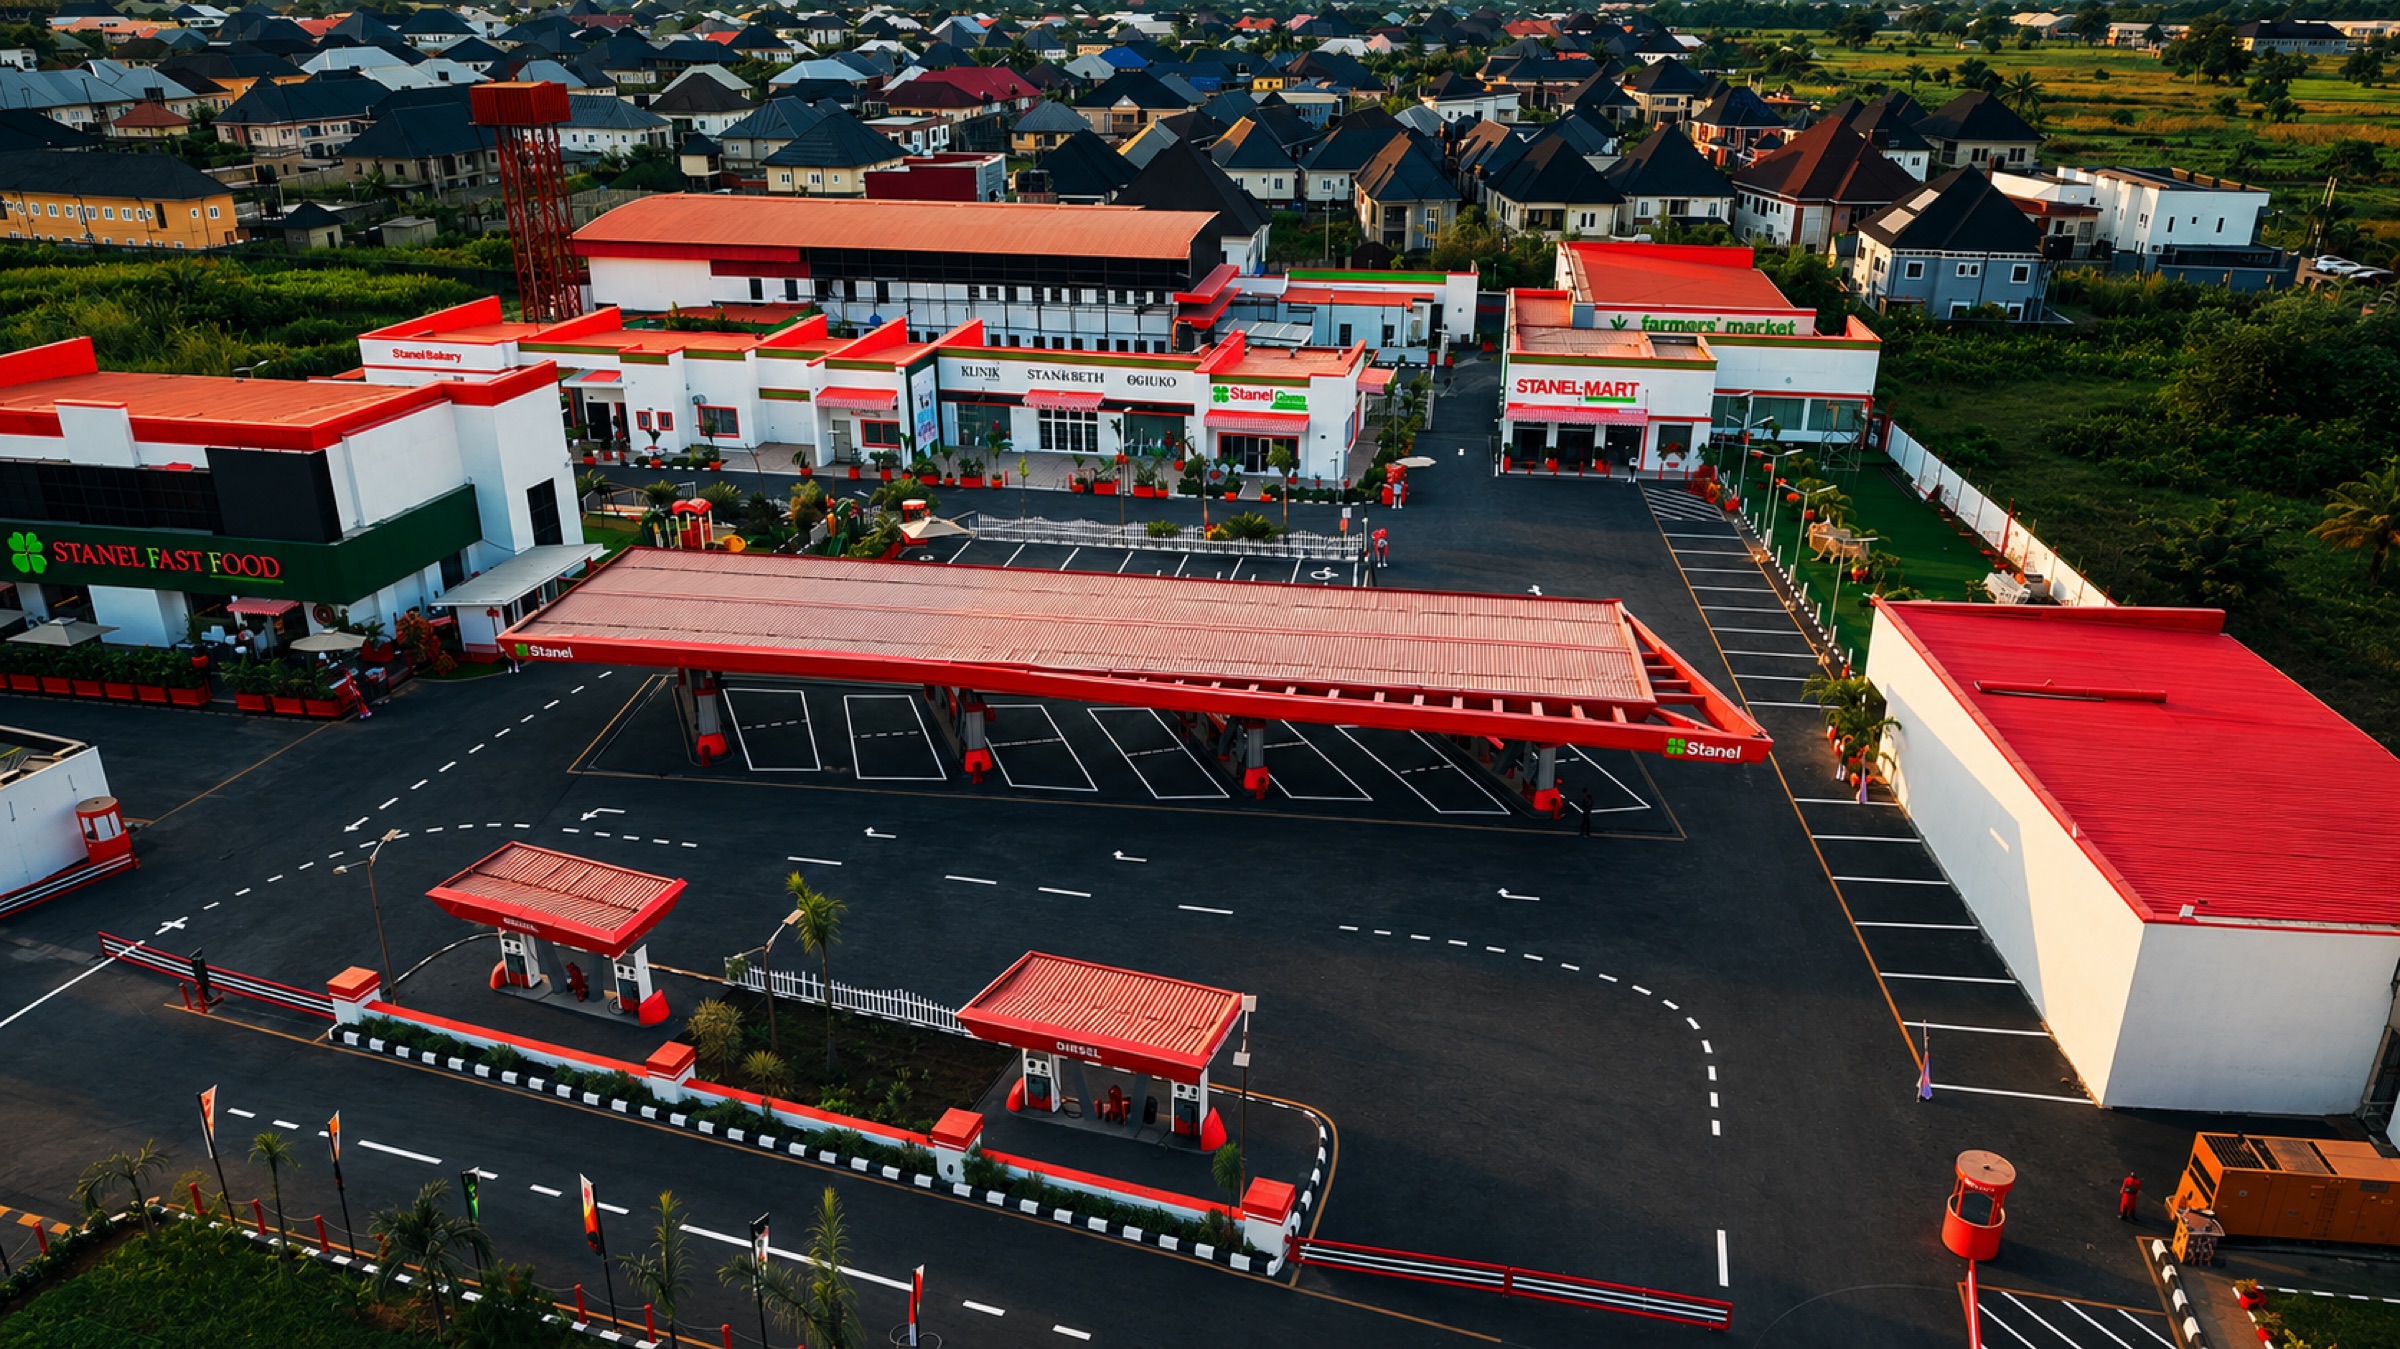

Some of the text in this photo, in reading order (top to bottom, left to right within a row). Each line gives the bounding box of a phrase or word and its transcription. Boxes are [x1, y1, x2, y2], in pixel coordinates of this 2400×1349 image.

[1726, 319, 1796, 335] market
[392, 348, 425, 359] Stanel
[961, 365, 1000, 377] KLINIK
[1230, 387, 1273, 402] Stanel
[53, 541, 281, 578] STANEL FAST FOOD
[530, 645, 574, 659] Stanel
[1686, 741, 1742, 760] Stanel
[1056, 1041, 1102, 1059] DIESEL
